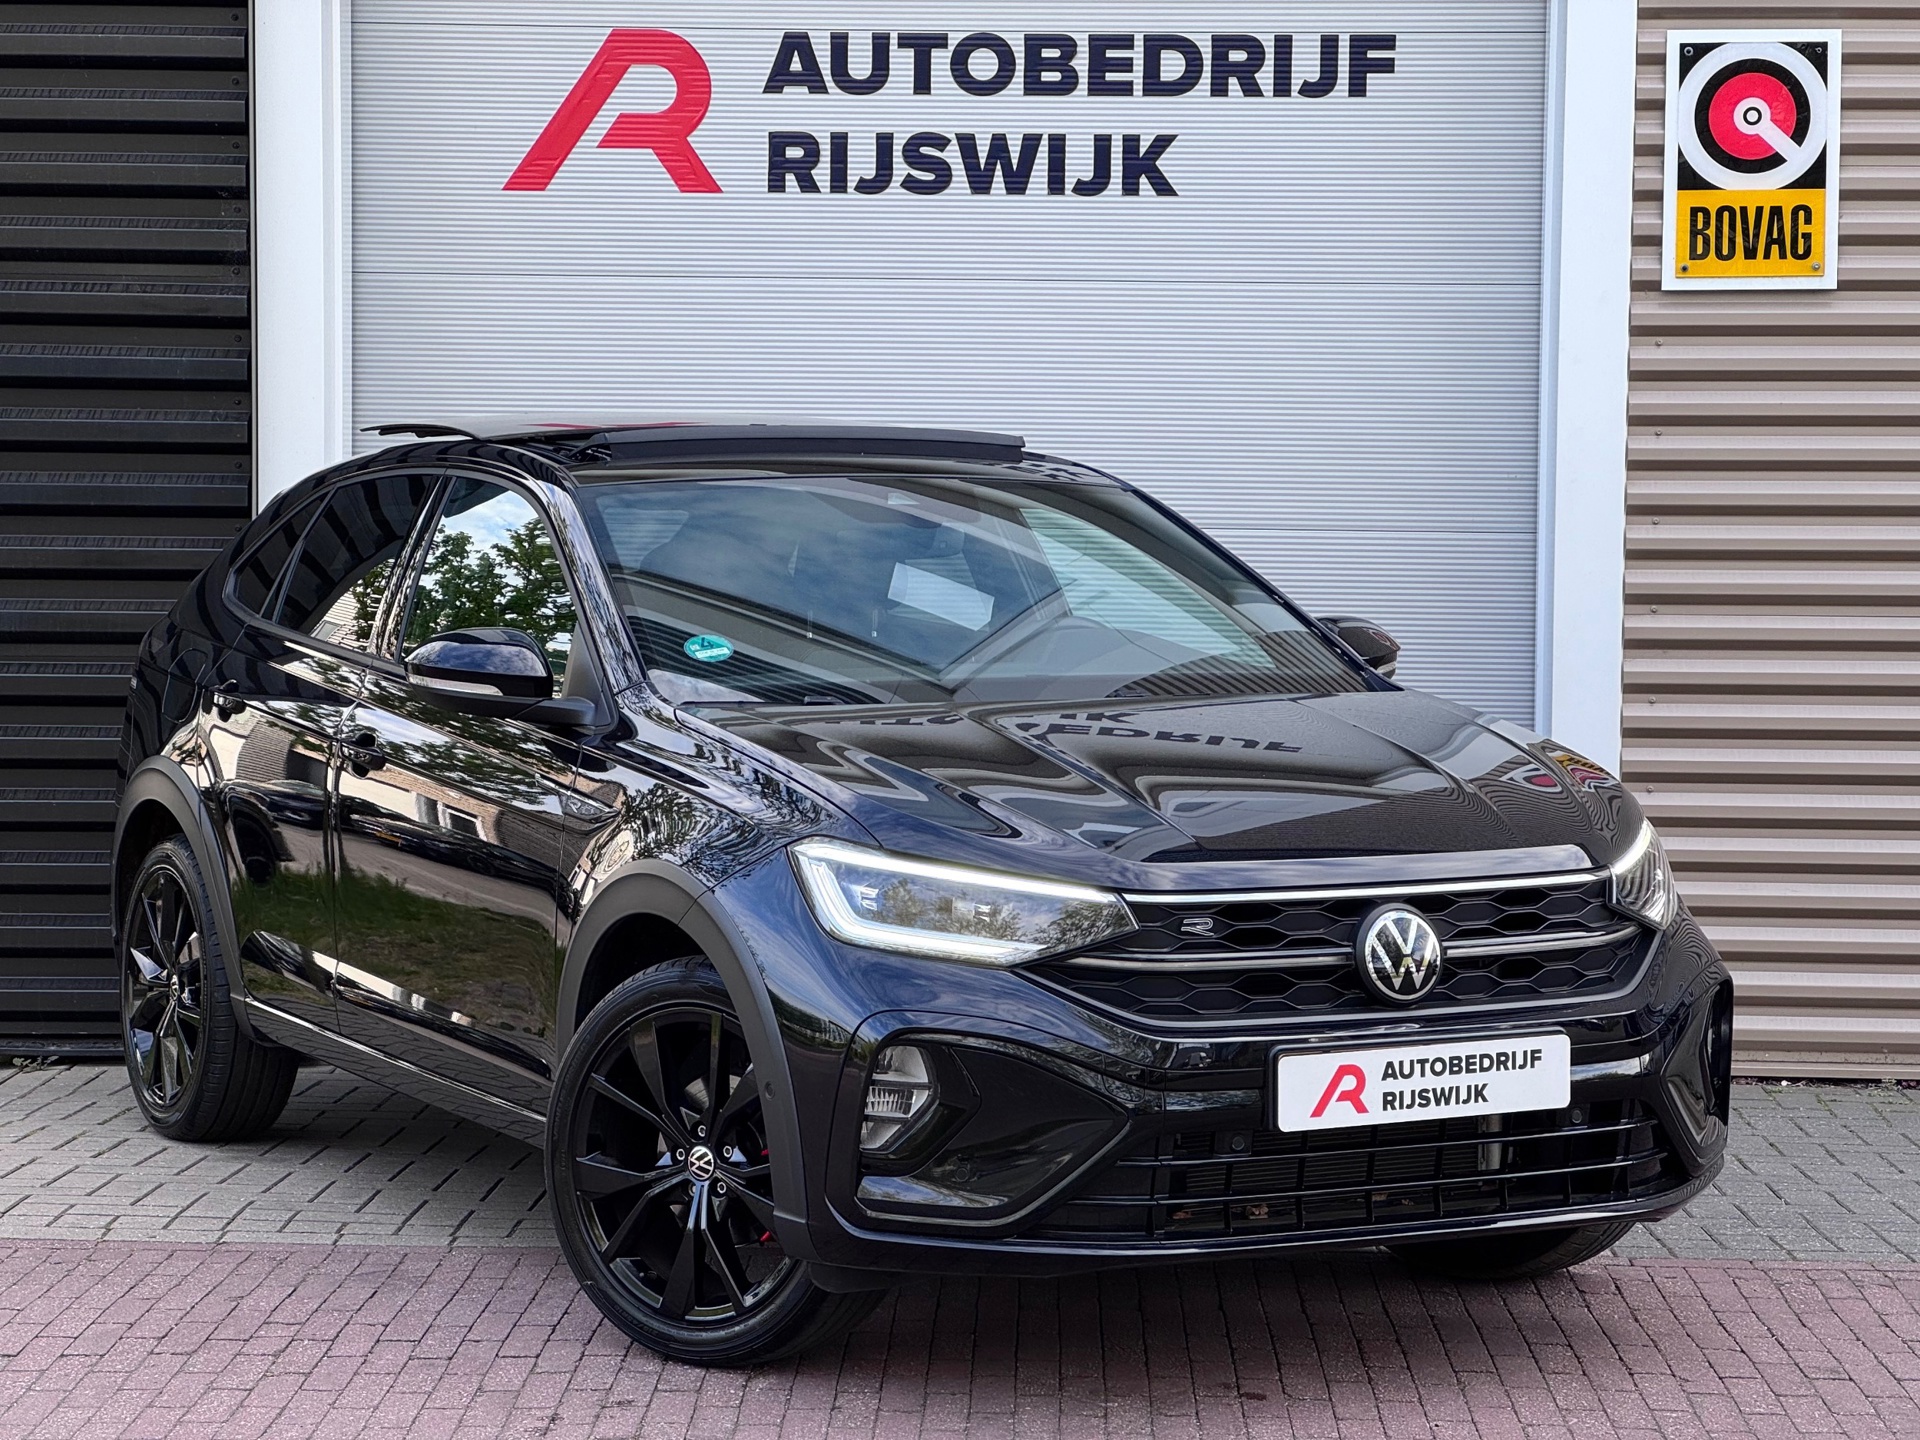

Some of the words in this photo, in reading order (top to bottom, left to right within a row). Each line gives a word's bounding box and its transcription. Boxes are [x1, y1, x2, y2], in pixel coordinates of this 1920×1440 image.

[762, 31, 1397, 98] AUTOBEDRIJF
[767, 131, 1179, 197] RIJSWIJK
[1688, 204, 1813, 262] BOVAG
[1381, 1048, 1543, 1081] AUTOBEDRIJF
[1382, 1082, 1489, 1111] RIJSWIJK
